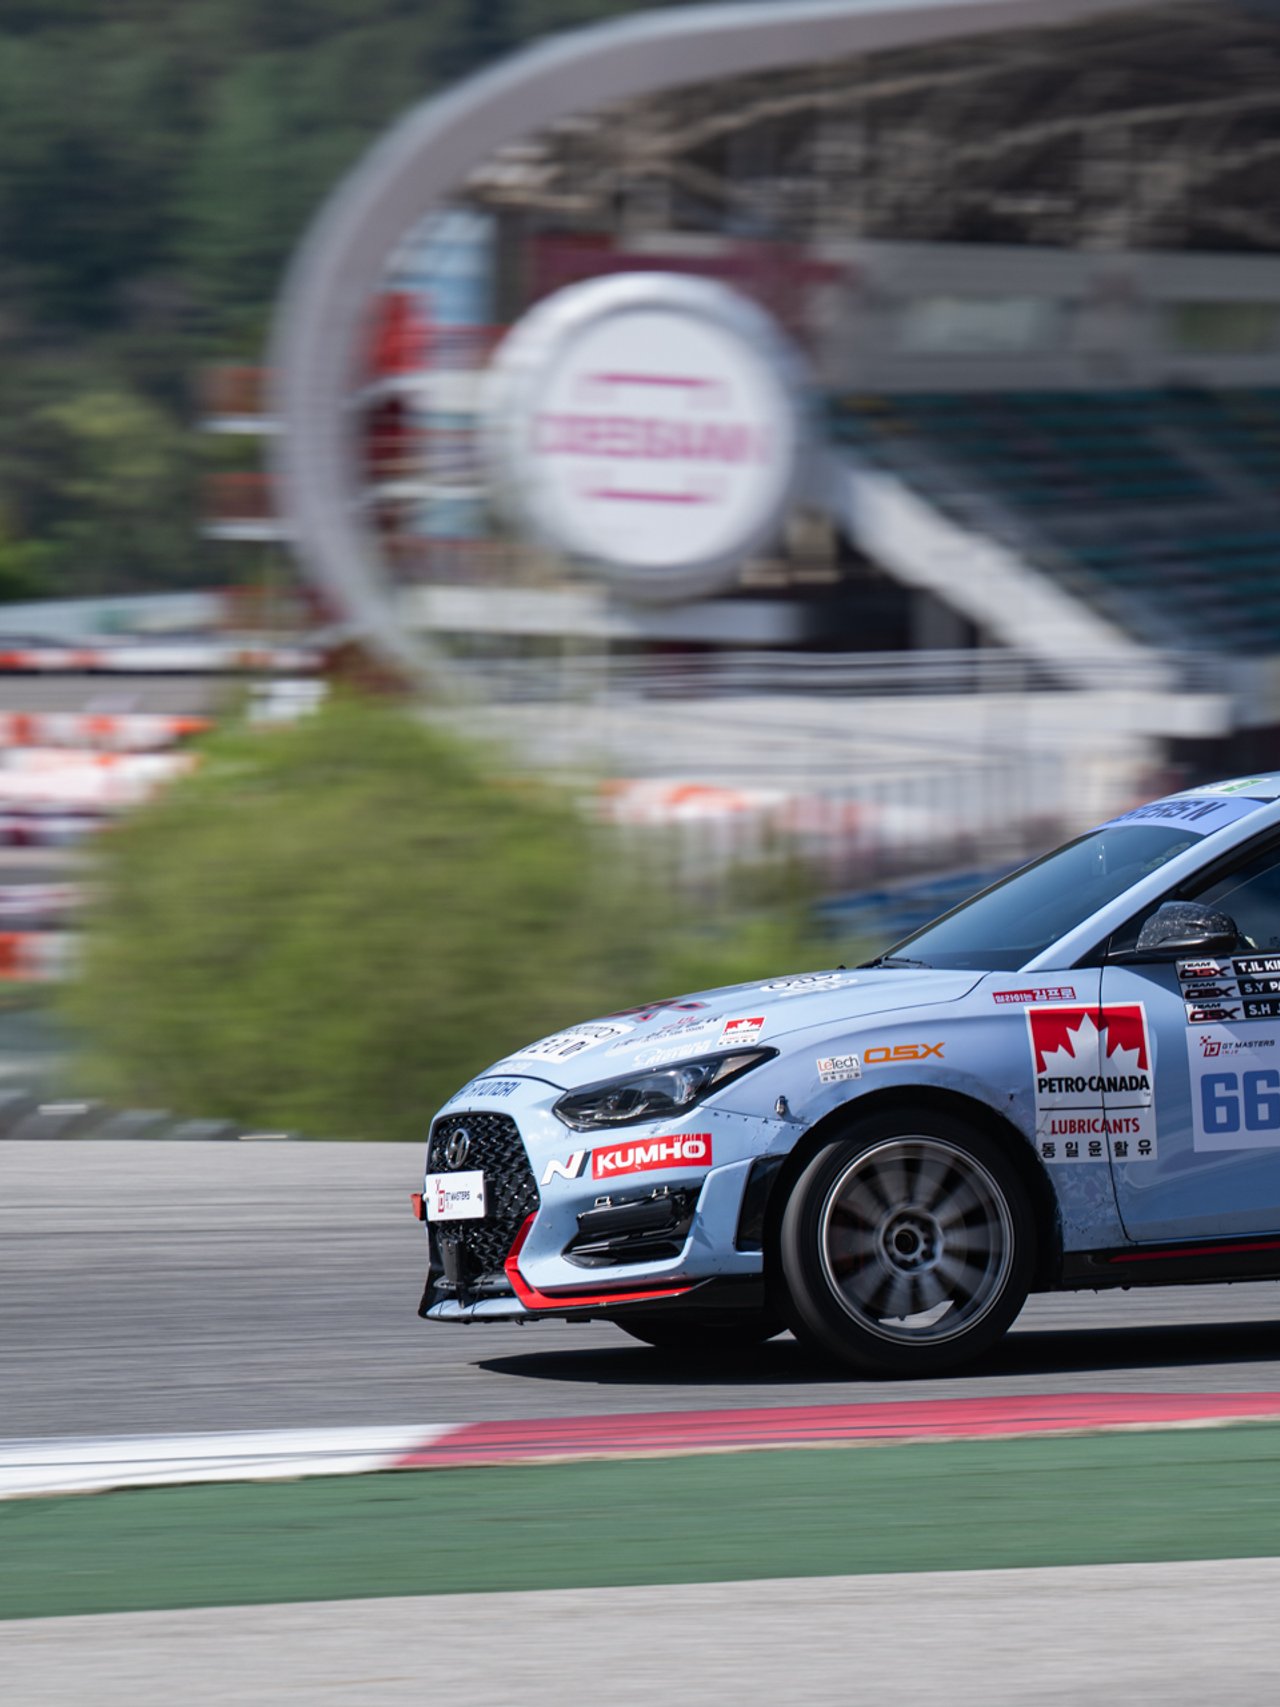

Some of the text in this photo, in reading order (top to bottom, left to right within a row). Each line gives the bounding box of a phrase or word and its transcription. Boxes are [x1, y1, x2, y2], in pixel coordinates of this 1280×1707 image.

[1184, 961, 1211, 969] TEAM
[1244, 982, 1264, 993] S.Y
[1248, 1004, 1271, 1015] S.H
[1235, 1040, 1276, 1049] MASTERS
[817, 1056, 859, 1072] LeTech
[1051, 1117, 1141, 1136] LUBRICANTS
[597, 1139, 706, 1172] KUMHO
